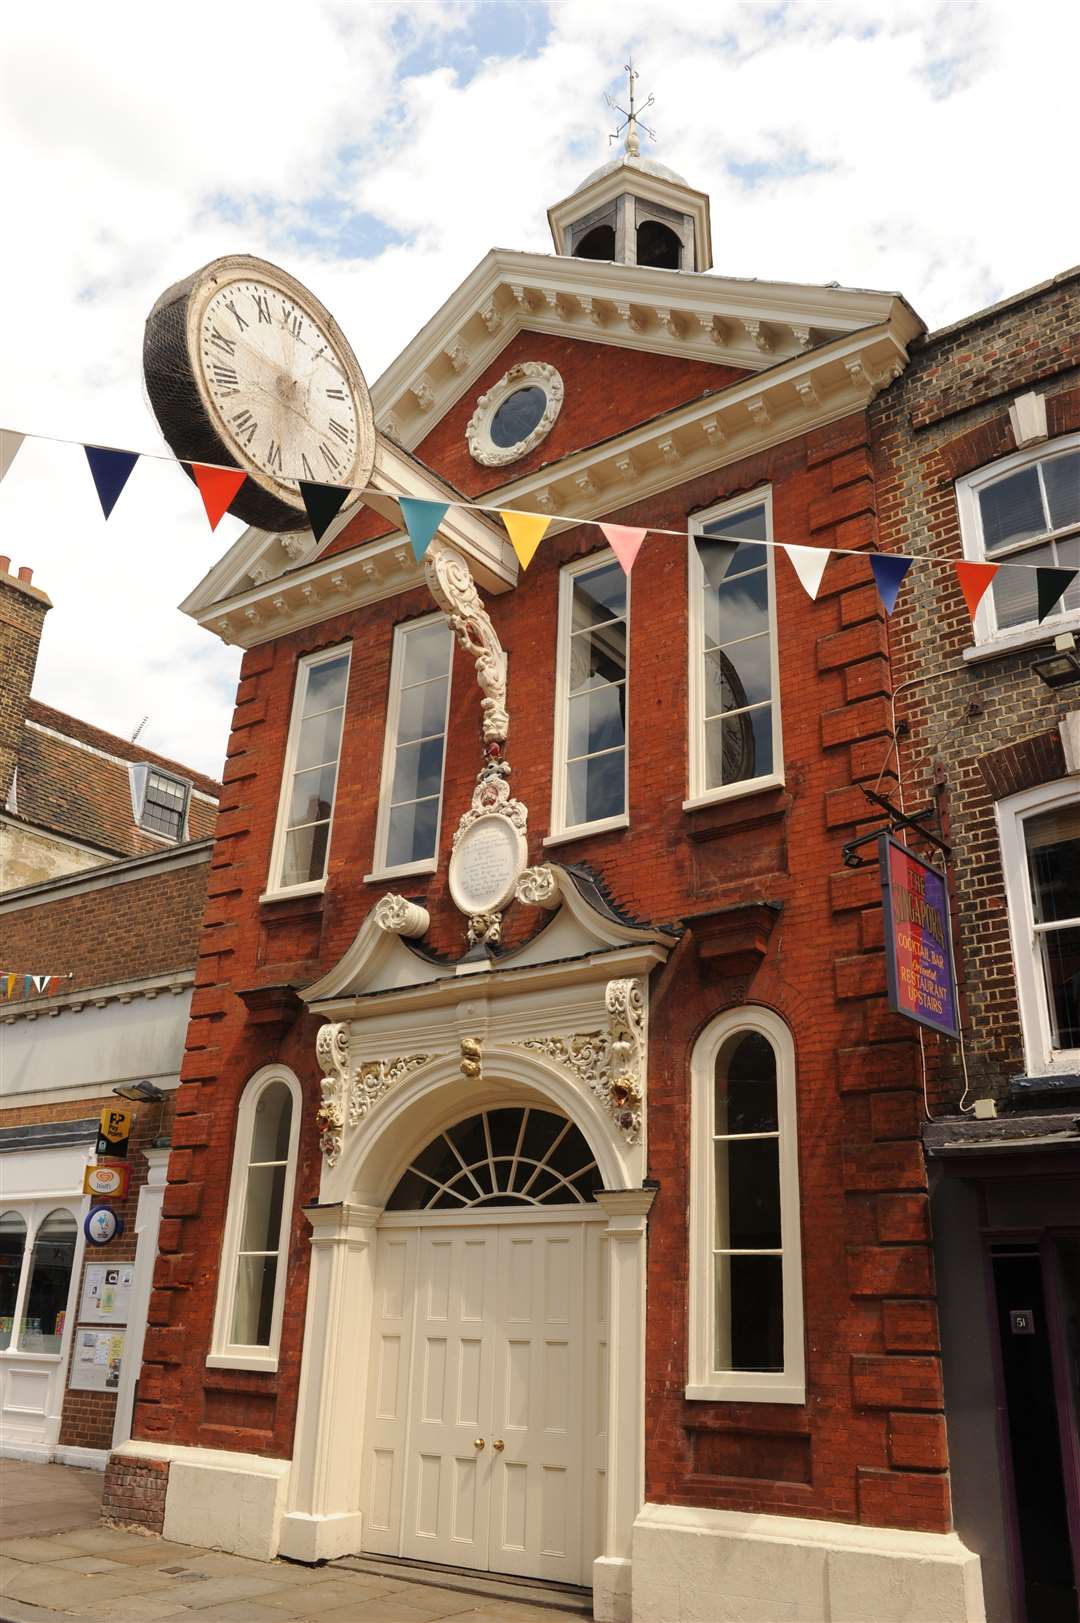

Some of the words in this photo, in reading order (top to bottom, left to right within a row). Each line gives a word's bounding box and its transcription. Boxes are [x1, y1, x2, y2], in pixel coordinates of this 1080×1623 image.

[225, 300, 249, 332] X
[251, 294, 272, 325] XI
[211, 326, 236, 357] IX
[213, 364, 240, 398] VIII
[325, 389, 345, 401] II
[231, 408, 258, 444] VII
[328, 418, 349, 445] III
[267, 440, 282, 472] VI
[301, 452, 316, 481] V
[318, 441, 340, 474] IV
[908, 869, 926, 897] THE
[898, 932, 930, 962] COCKTAIL
[931, 950, 945, 971] BAR
[900, 966, 948, 1001] RESTAURANT
[908, 985, 943, 1014] UPSTAIRS
[1016, 1317, 1026, 1328] 51
